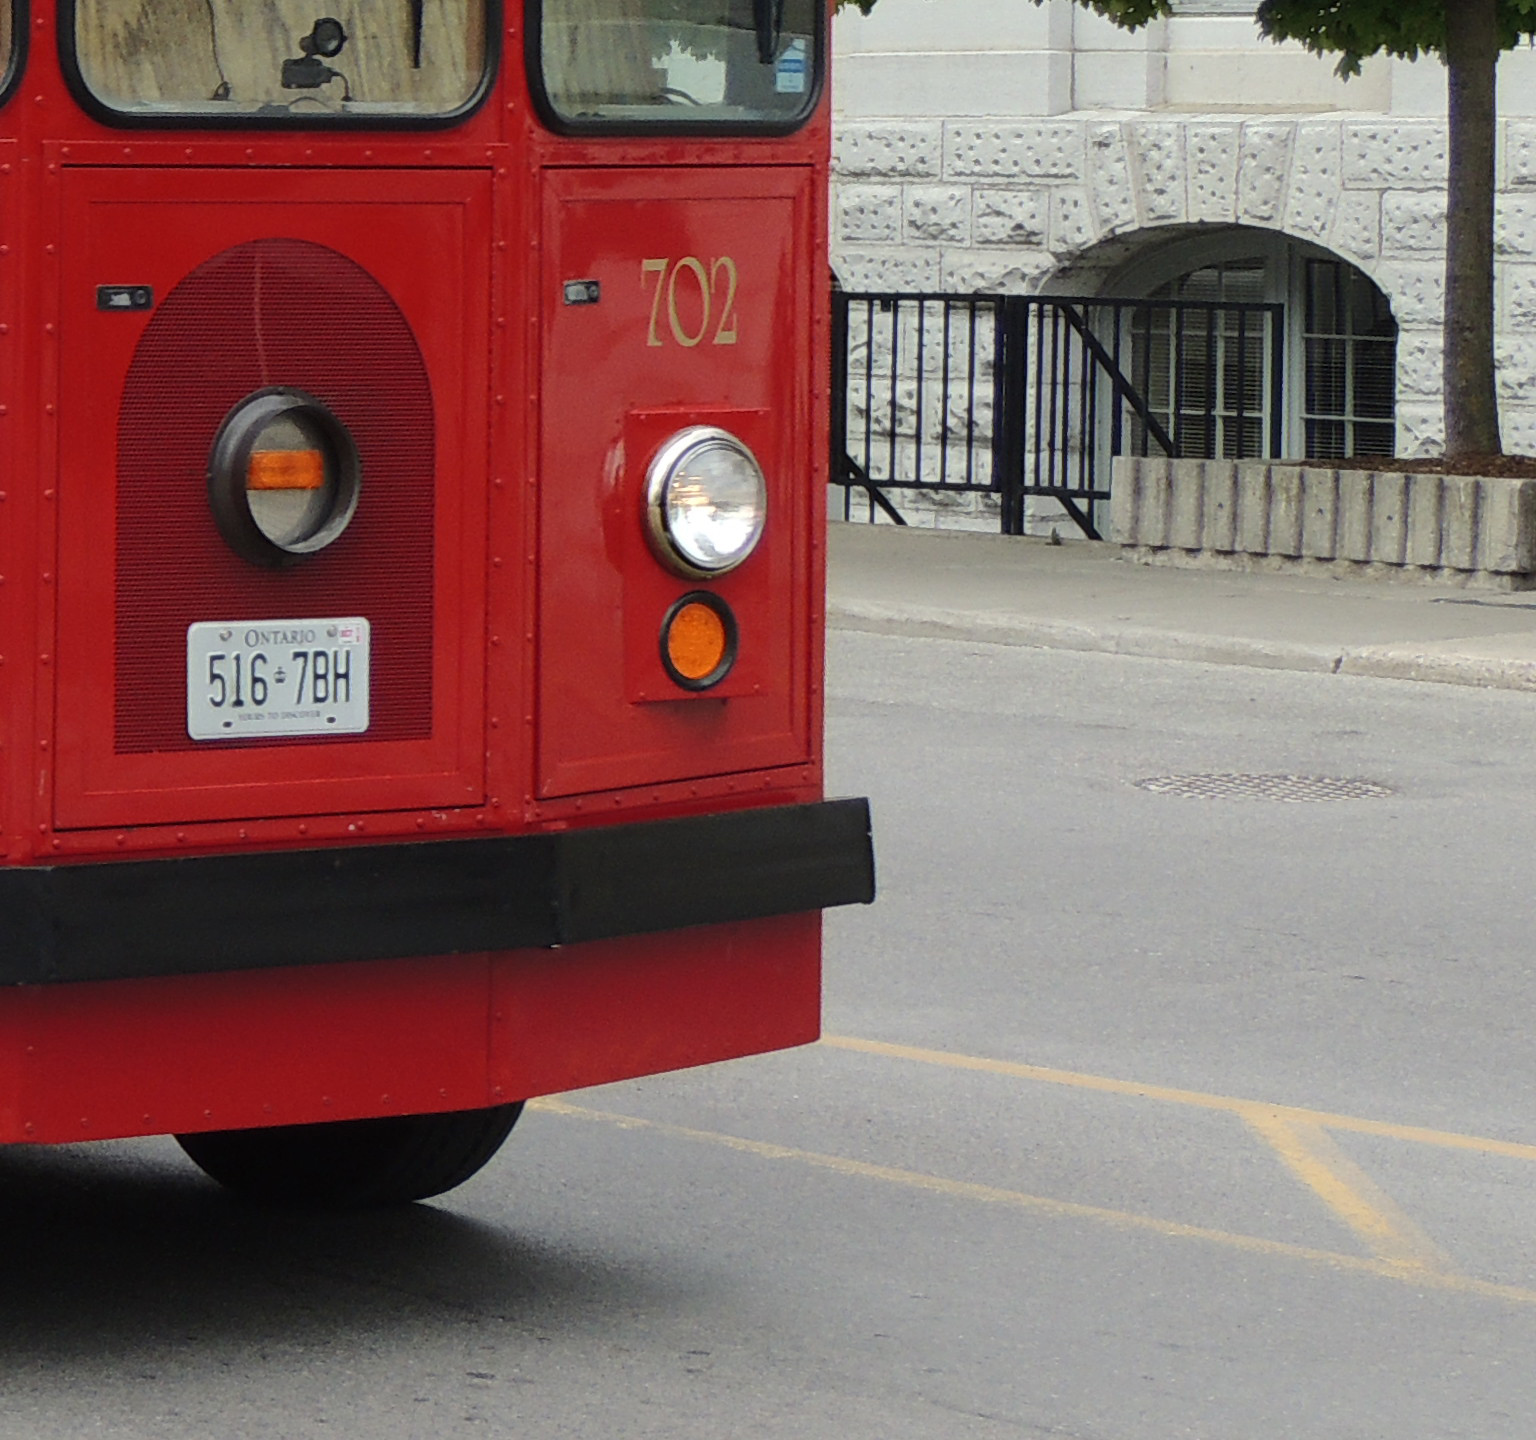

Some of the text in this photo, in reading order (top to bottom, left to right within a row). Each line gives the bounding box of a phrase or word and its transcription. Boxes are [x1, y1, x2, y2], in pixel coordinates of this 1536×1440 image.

[641, 255, 740, 347] 702
[244, 629, 316, 648] ONTARIO
[209, 649, 351, 708] 516 7BH
